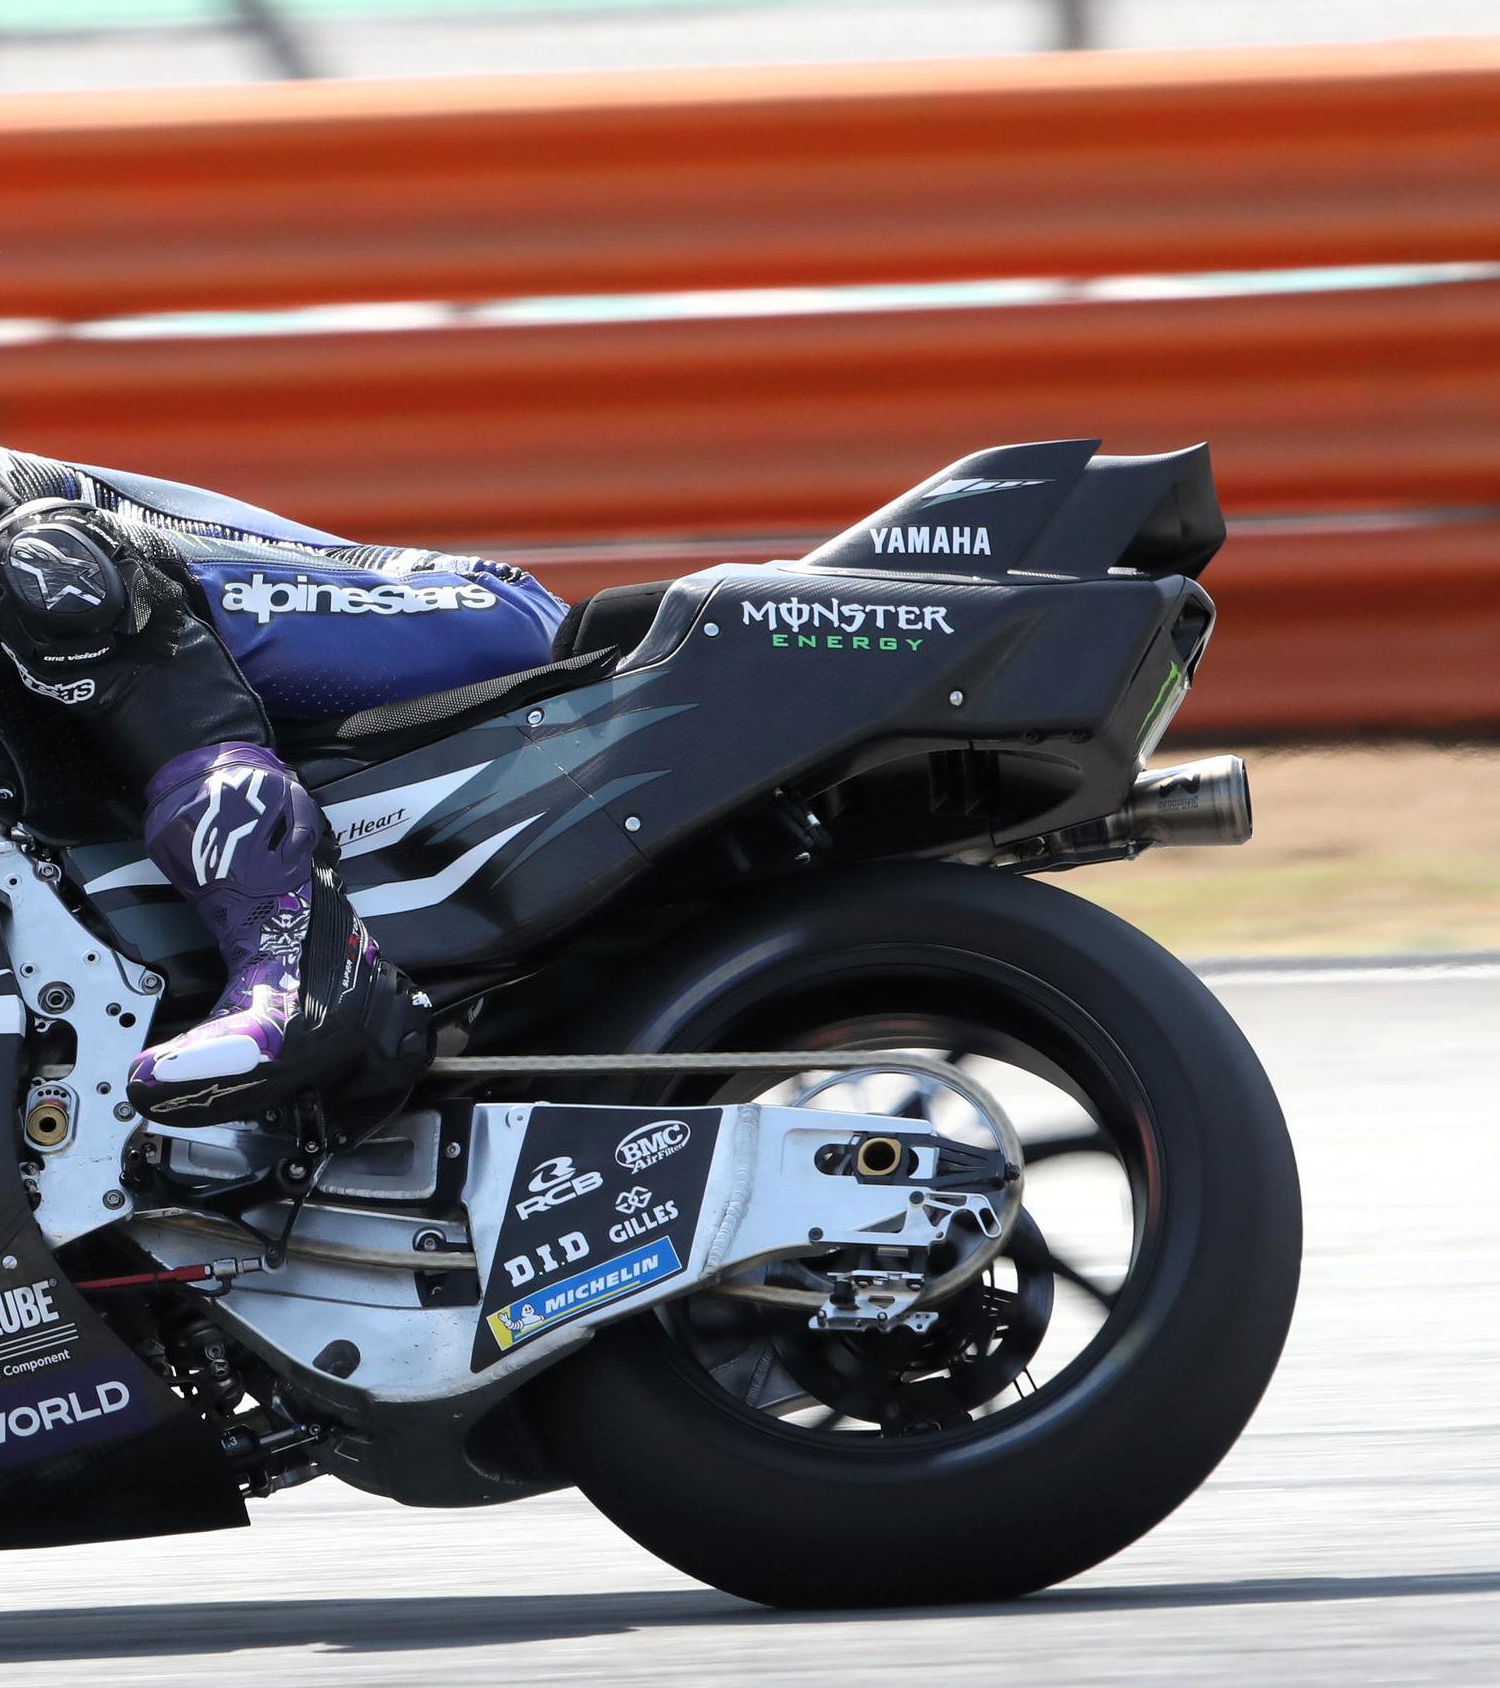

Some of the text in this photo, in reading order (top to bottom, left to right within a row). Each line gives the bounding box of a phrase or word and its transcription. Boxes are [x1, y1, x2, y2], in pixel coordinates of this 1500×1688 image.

[869, 526, 992, 556] YAMAHA
[222, 573, 496, 624] alpinestars
[741, 597, 954, 634] MONSTER
[772, 634, 924, 651] ENERGY
[349, 808, 406, 840] Heart
[620, 1124, 683, 1164] BMC
[515, 1171, 604, 1221] RCB
[609, 1200, 679, 1243] GILLES
[504, 1231, 590, 1288] D.I.D
[545, 1254, 659, 1314] MICHELIN
[3, 1349, 71, 1377] Component
